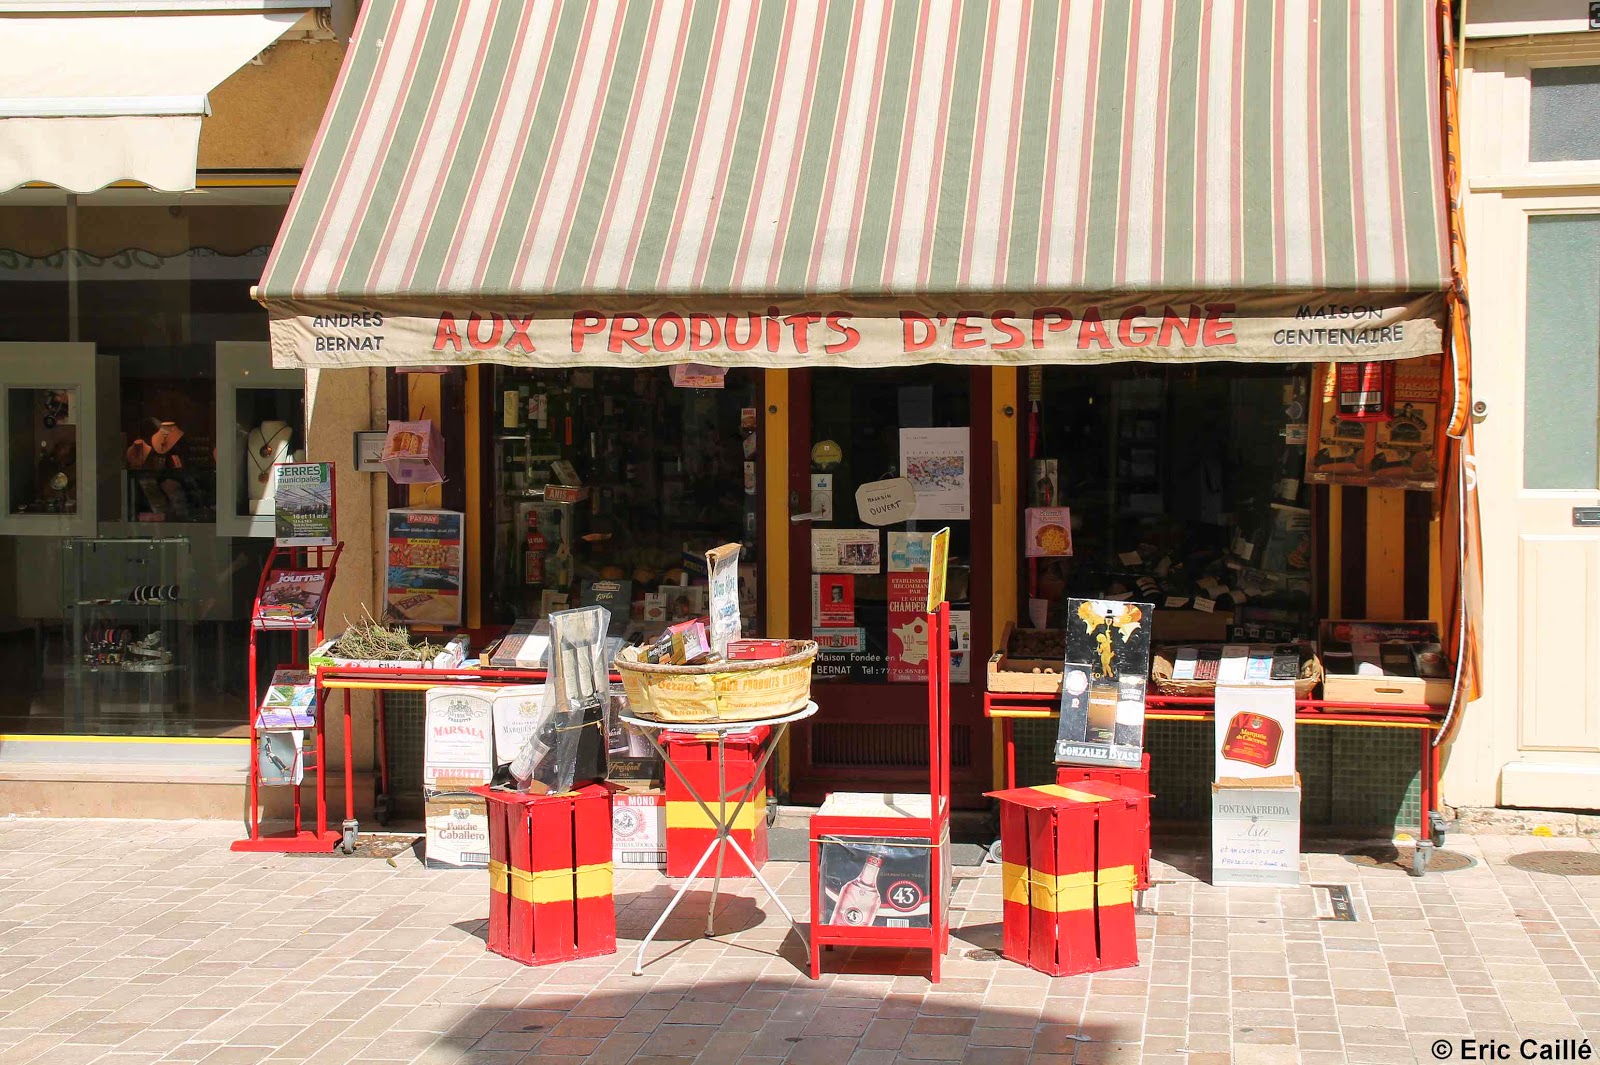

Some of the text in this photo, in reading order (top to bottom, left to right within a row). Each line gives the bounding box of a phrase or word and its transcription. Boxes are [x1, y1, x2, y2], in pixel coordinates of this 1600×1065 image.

[312, 306, 384, 328] ANDRÈS
[1295, 304, 1384, 321] MAISON
[432, 310, 537, 354] AUX
[902, 302, 1237, 353] D'ESPAGNE
[1272, 325, 1404, 346] CENTENAIRE
[315, 336, 385, 352] BERNAT
[277, 465, 321, 477] SERRES
[278, 475, 321, 485] municipales
[549, 489, 567, 499] ANIS
[869, 500, 901, 516] OUVERT
[277, 572, 325, 584] journal
[889, 601, 941, 612] CHAMPERD
[840, 633, 858, 646] FUTÉ
[817, 653, 846, 662] Maison
[850, 653, 881, 662] Fondée
[816, 666, 851, 674] BERNAT
[433, 724, 485, 740] MARSALA
[432, 766, 485, 779] FRAZZITTA
[628, 796, 655, 806] MONO
[1218, 803, 1291, 816] FONTANAFREDDA
[446, 822, 478, 831] Ponche
[438, 830, 485, 842] Caballero
[892, 887, 914, 904] 43
